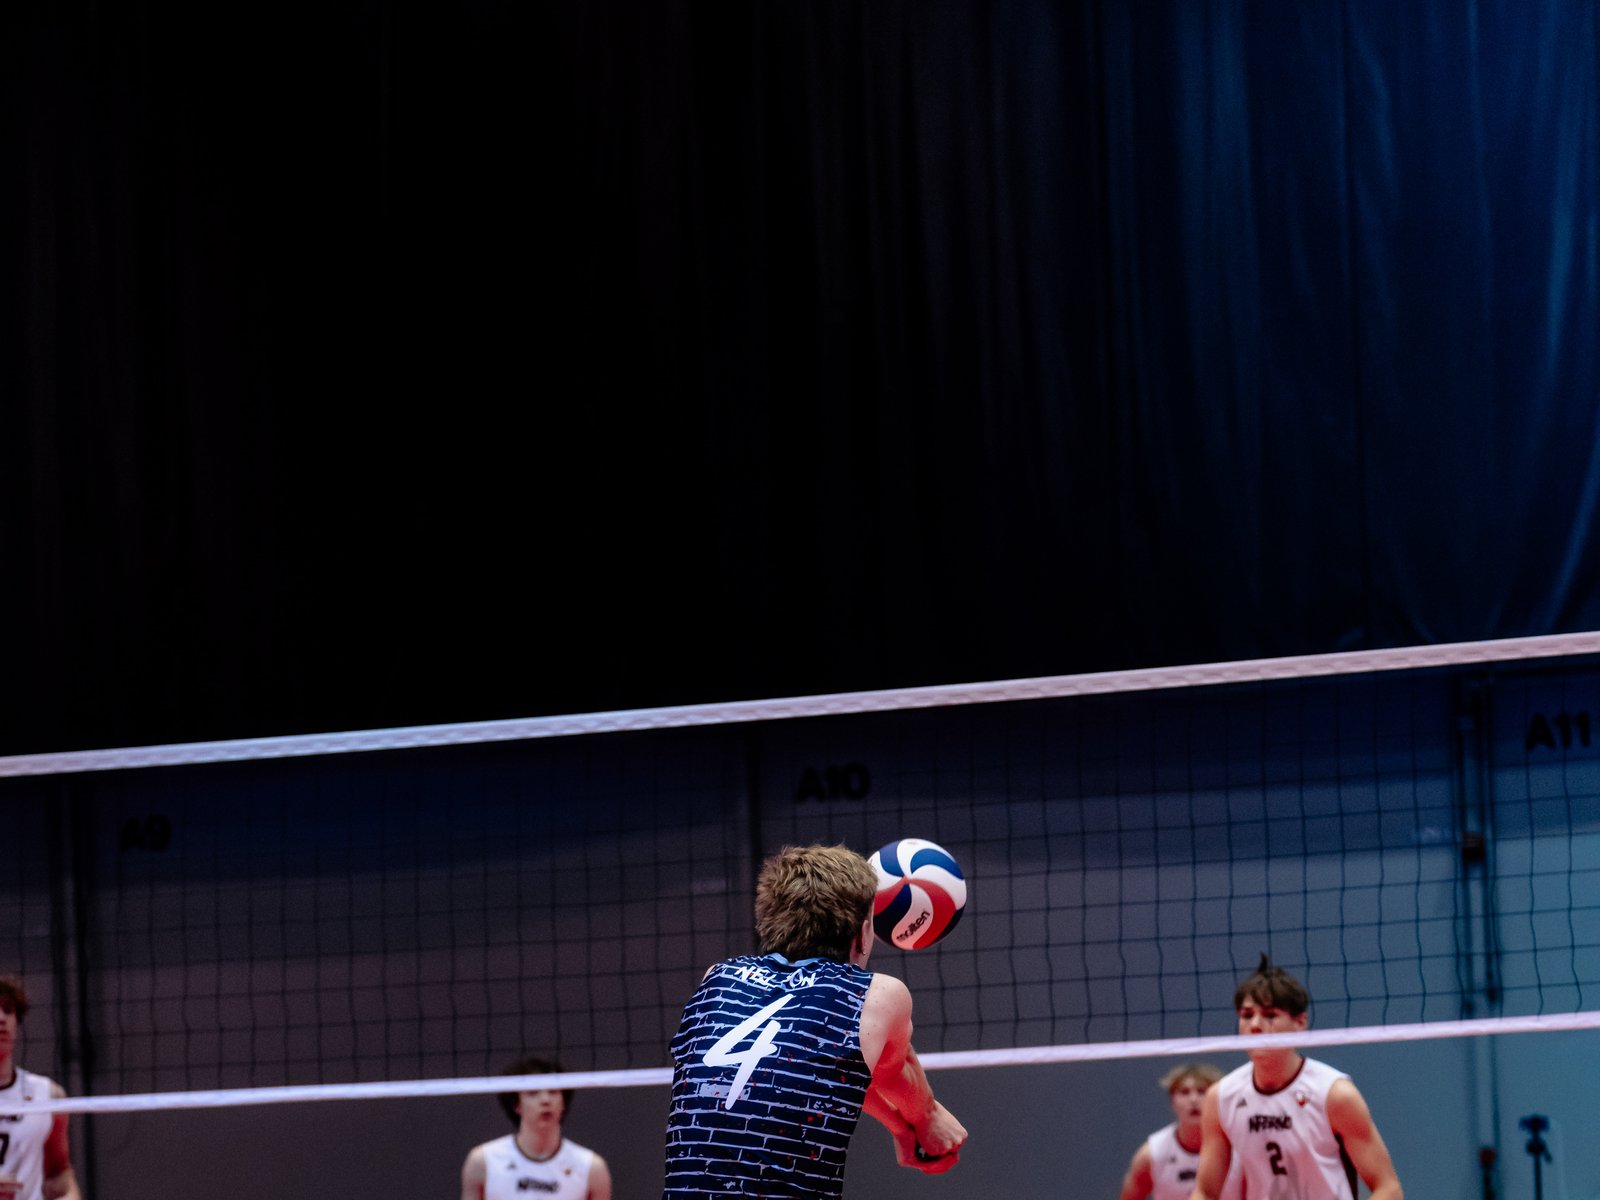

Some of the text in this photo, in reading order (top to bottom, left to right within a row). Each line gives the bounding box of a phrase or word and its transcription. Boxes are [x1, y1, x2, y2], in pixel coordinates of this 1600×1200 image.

[1526, 713, 1590, 750] A11
[797, 764, 869, 801] A10
[121, 815, 170, 851] A9
[896, 910, 931, 941] molten
[702, 993, 782, 1110] 4
[1266, 1142, 1288, 1175] 2
